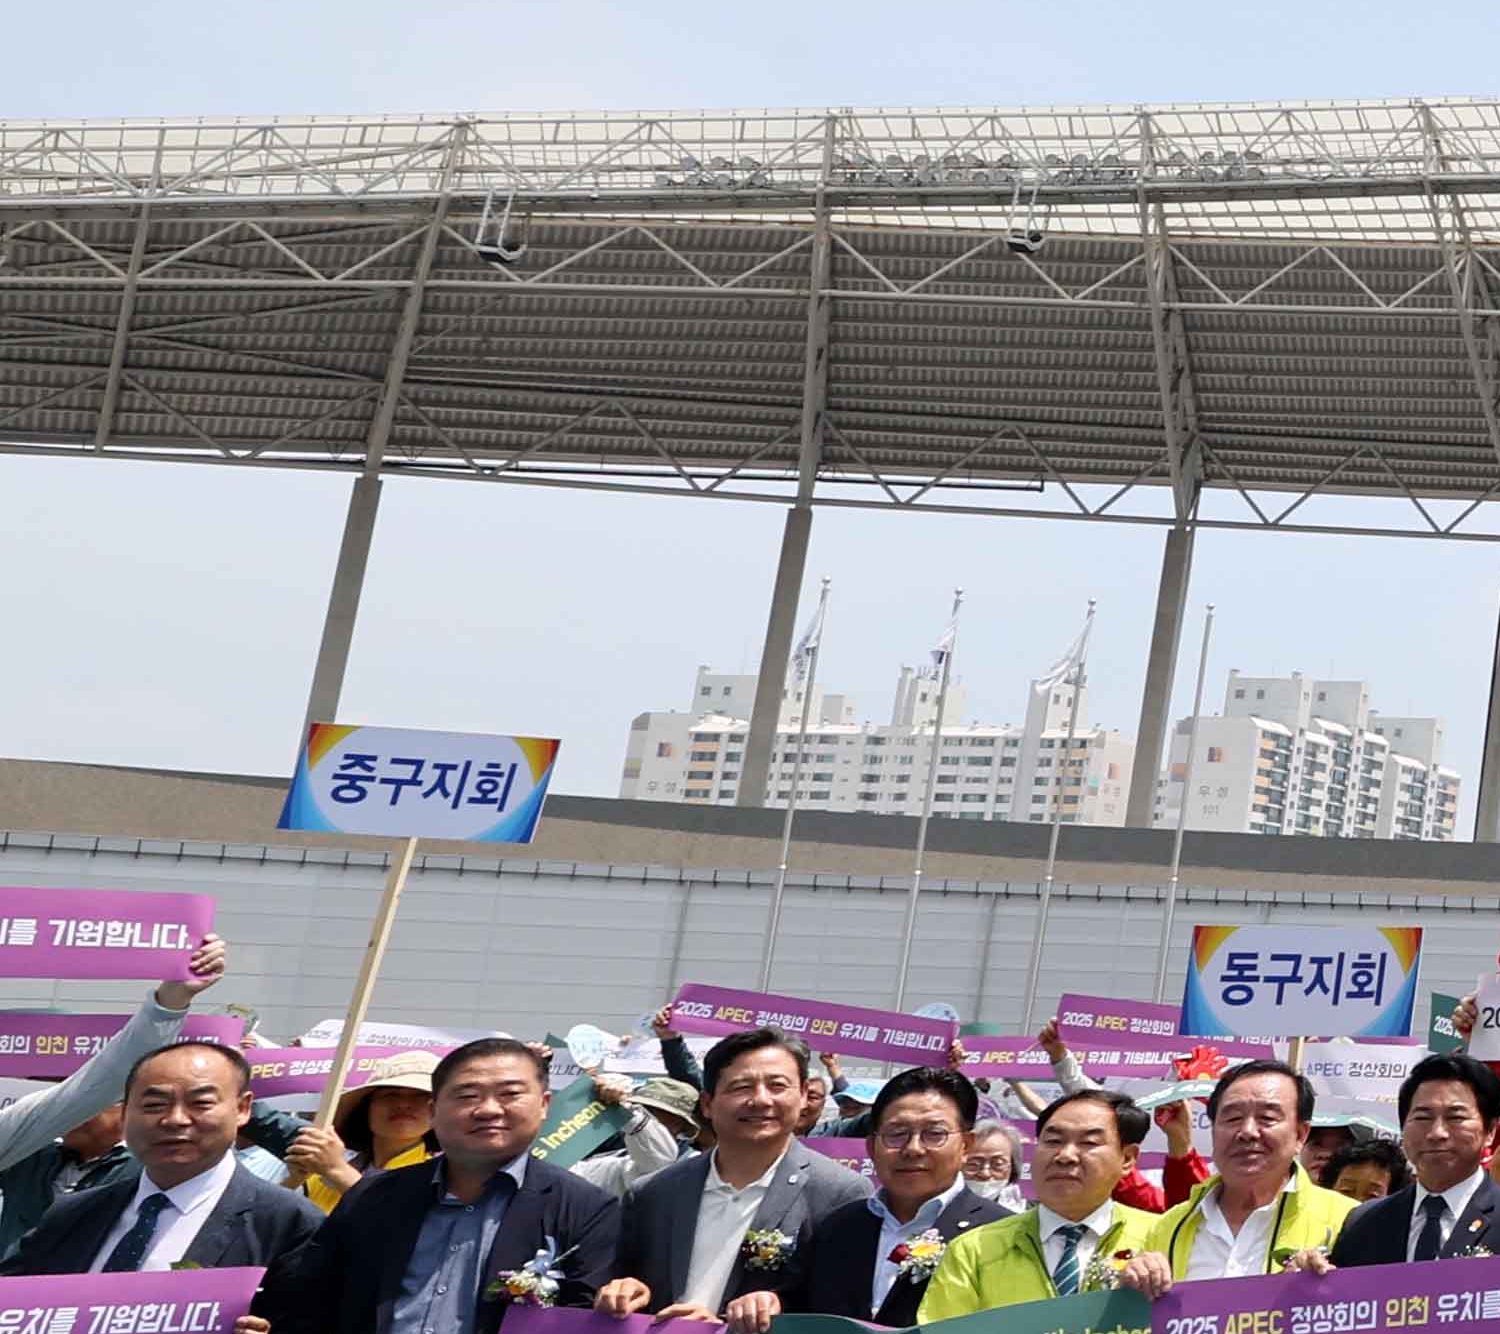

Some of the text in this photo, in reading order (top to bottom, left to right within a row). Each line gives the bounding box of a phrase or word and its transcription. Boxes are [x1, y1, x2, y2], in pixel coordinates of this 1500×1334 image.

[328, 752, 517, 812] 중구지회
[49, 919, 192, 949] 기원합니다.
[1219, 951, 1387, 1007] 동구지회
[673, 1001, 879, 1043] 2025 APEC 정상회의 인천 유치를
[1062, 1012, 1175, 1036] 2025 APEC 정상회의
[35, 1035, 68, 1054] 인천
[982, 1051, 1013, 1064] APEC
[1307, 1061, 1408, 1079] APEC 정상회의
[544, 1101, 607, 1151] Incheon
[1290, 1300, 1377, 1334] 정상회의
[1385, 1295, 1430, 1327] 인천
